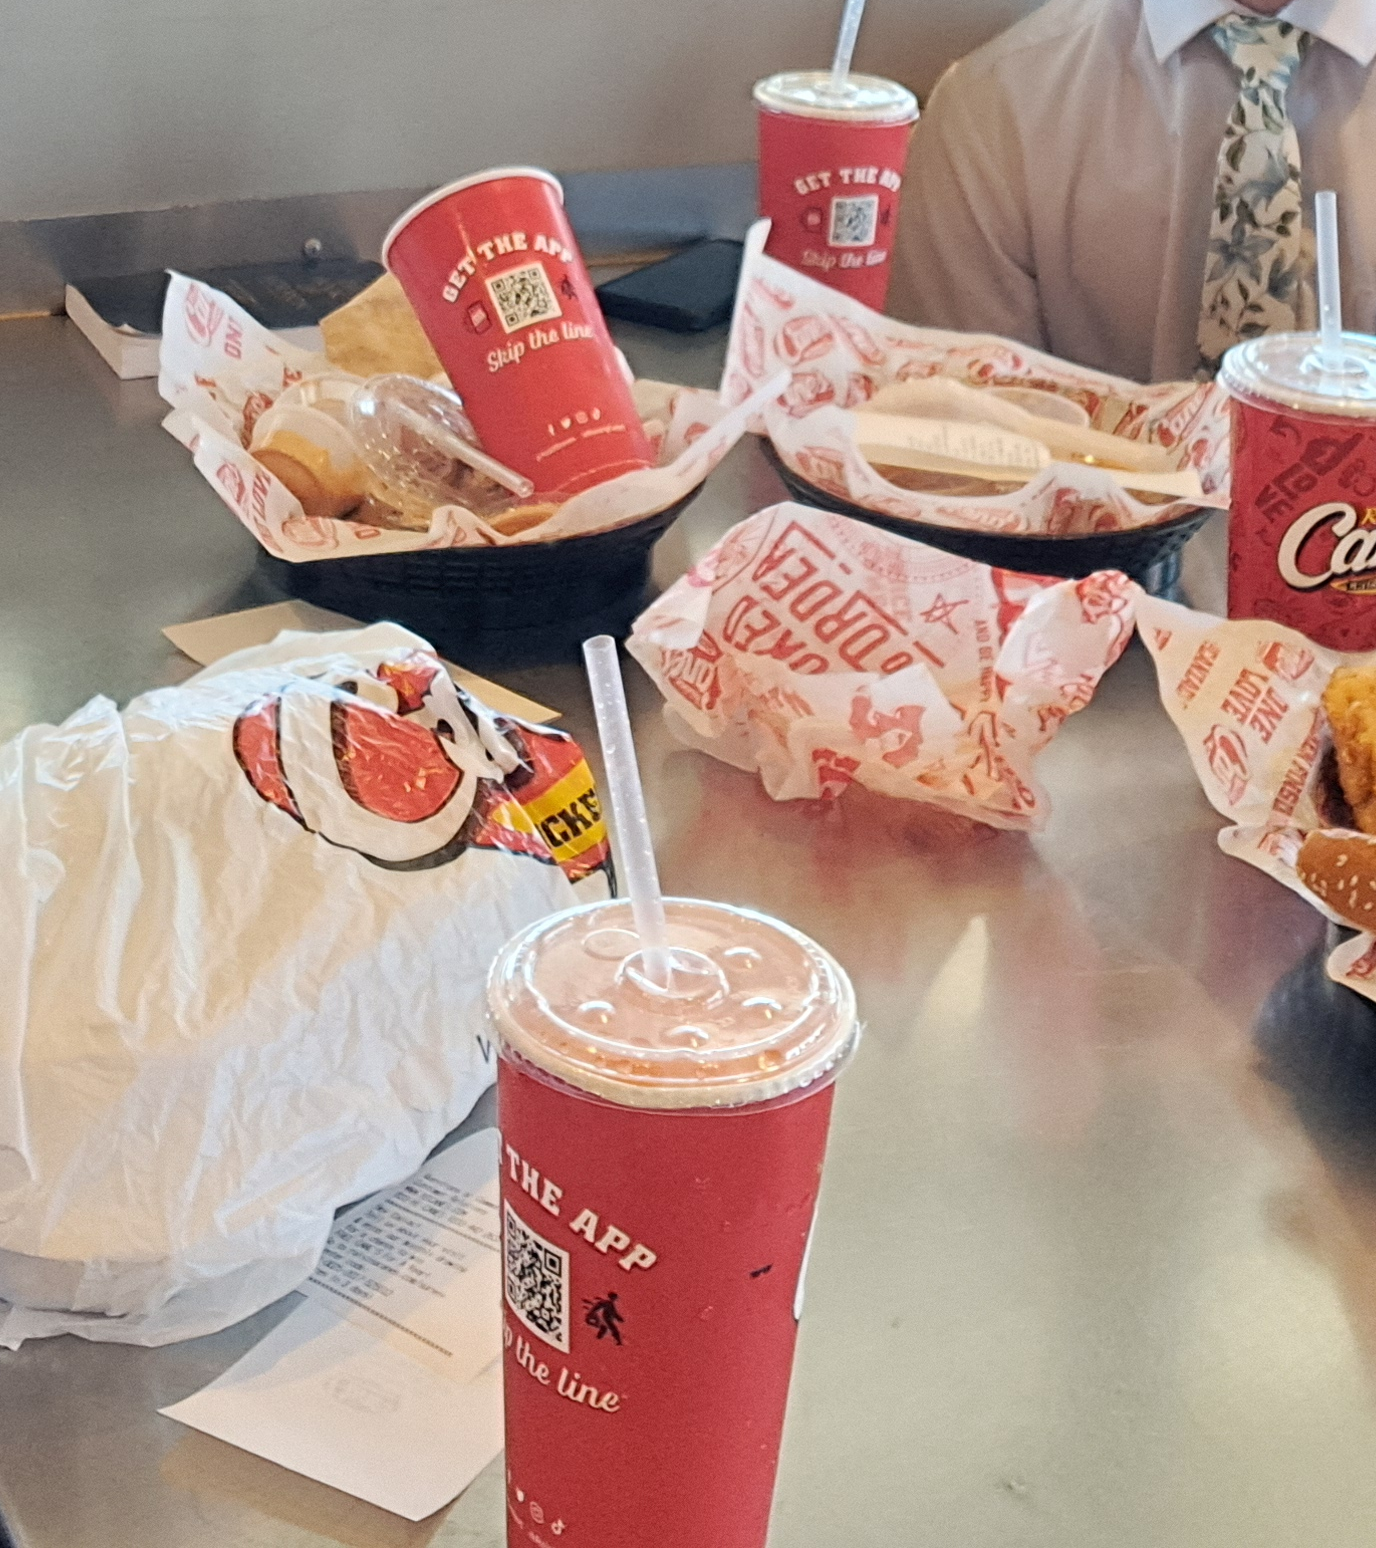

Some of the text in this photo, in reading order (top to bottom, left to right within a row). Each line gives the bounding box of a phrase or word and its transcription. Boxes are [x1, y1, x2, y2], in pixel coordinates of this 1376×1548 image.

[442, 254, 477, 303] GET
[477, 231, 528, 262] THE
[486, 321, 595, 373] Skip the line
[504, 1144, 564, 1216] THE
[568, 1208, 658, 1272] APP
[516, 1334, 551, 1386] the
[557, 1366, 622, 1414] line
